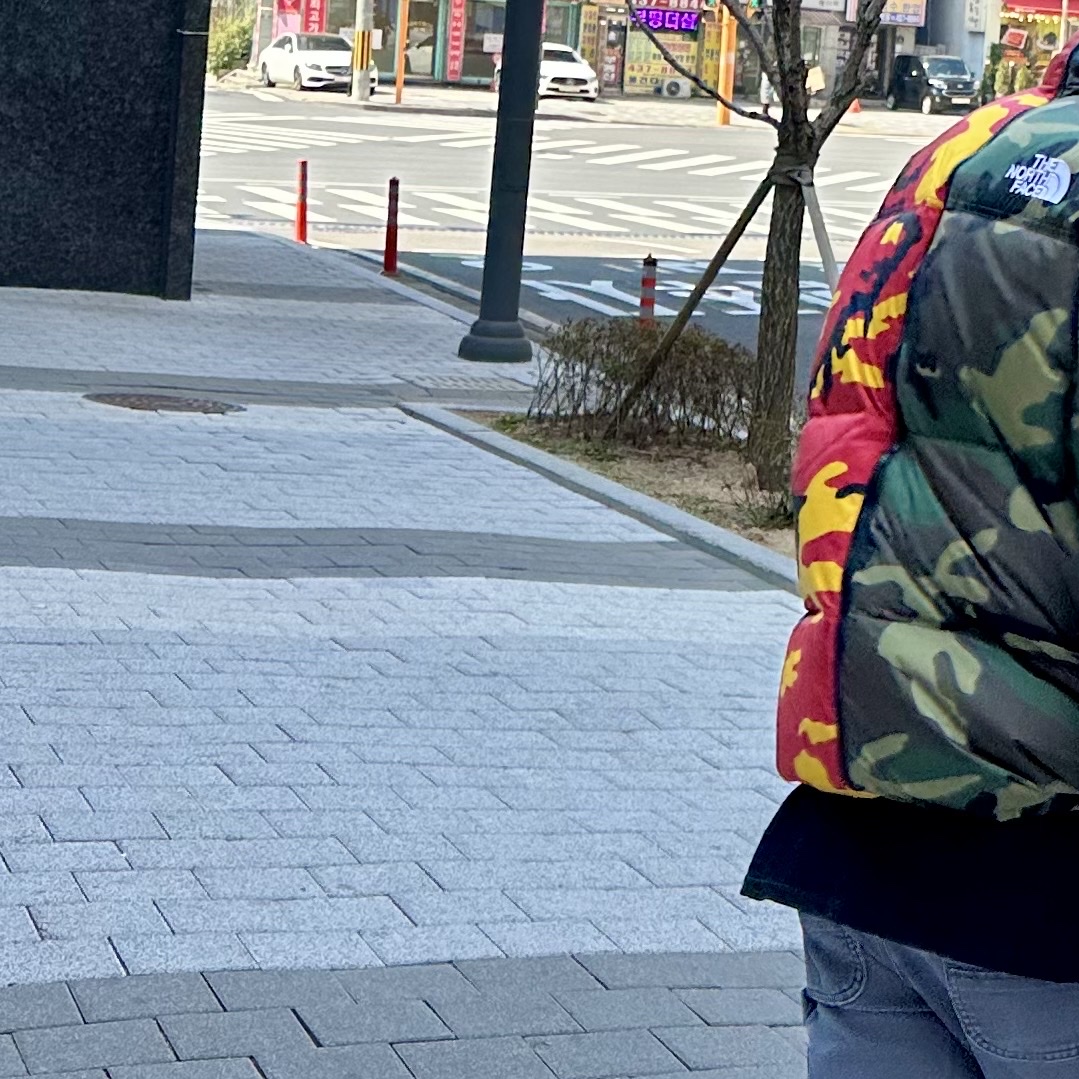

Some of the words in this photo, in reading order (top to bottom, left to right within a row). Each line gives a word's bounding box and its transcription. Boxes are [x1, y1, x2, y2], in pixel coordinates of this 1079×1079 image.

[1033, 153, 1059, 171] THE
[1004, 163, 1050, 186] NORTH
[1009, 179, 1048, 197] FACE
